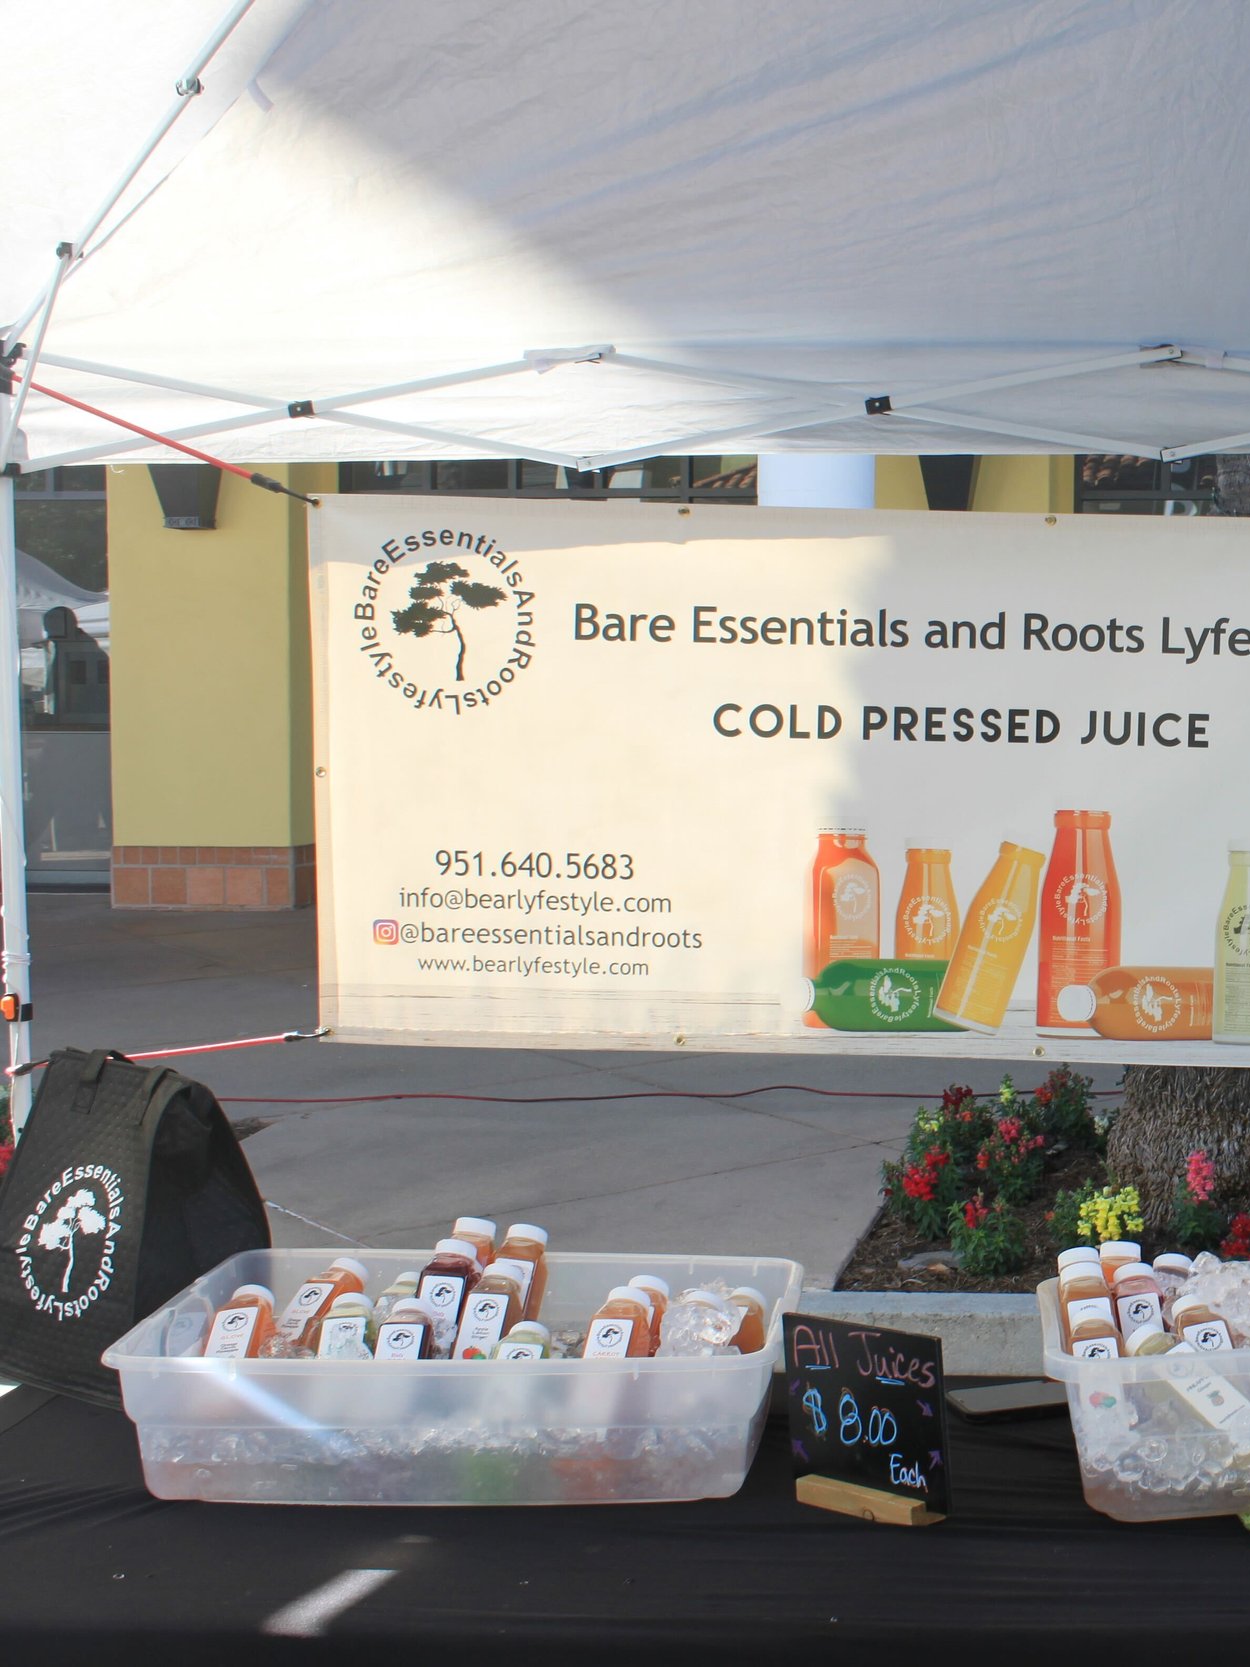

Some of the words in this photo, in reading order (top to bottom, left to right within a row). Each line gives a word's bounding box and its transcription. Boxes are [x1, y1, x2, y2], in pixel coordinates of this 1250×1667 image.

[574, 603, 675, 642] Bare
[692, 605, 909, 649] Essentials
[924, 611, 1005, 650] and
[1023, 613, 1145, 653] Roots
[713, 703, 843, 740] COLD
[862, 706, 1061, 744] PRESSED
[1081, 710, 1210, 749] JUICE
[435, 850, 634, 880] 951.640.5683
[399, 887, 672, 916] info@bearlyfestyle.com
[400, 922, 703, 949] @bareessentialsandroots
[418, 955, 649, 978] www.bearlyfestyle.com
[792, 1324, 839, 1368] All
[848, 1330, 936, 1388] Juices
[889, 1453, 928, 1489] Each
